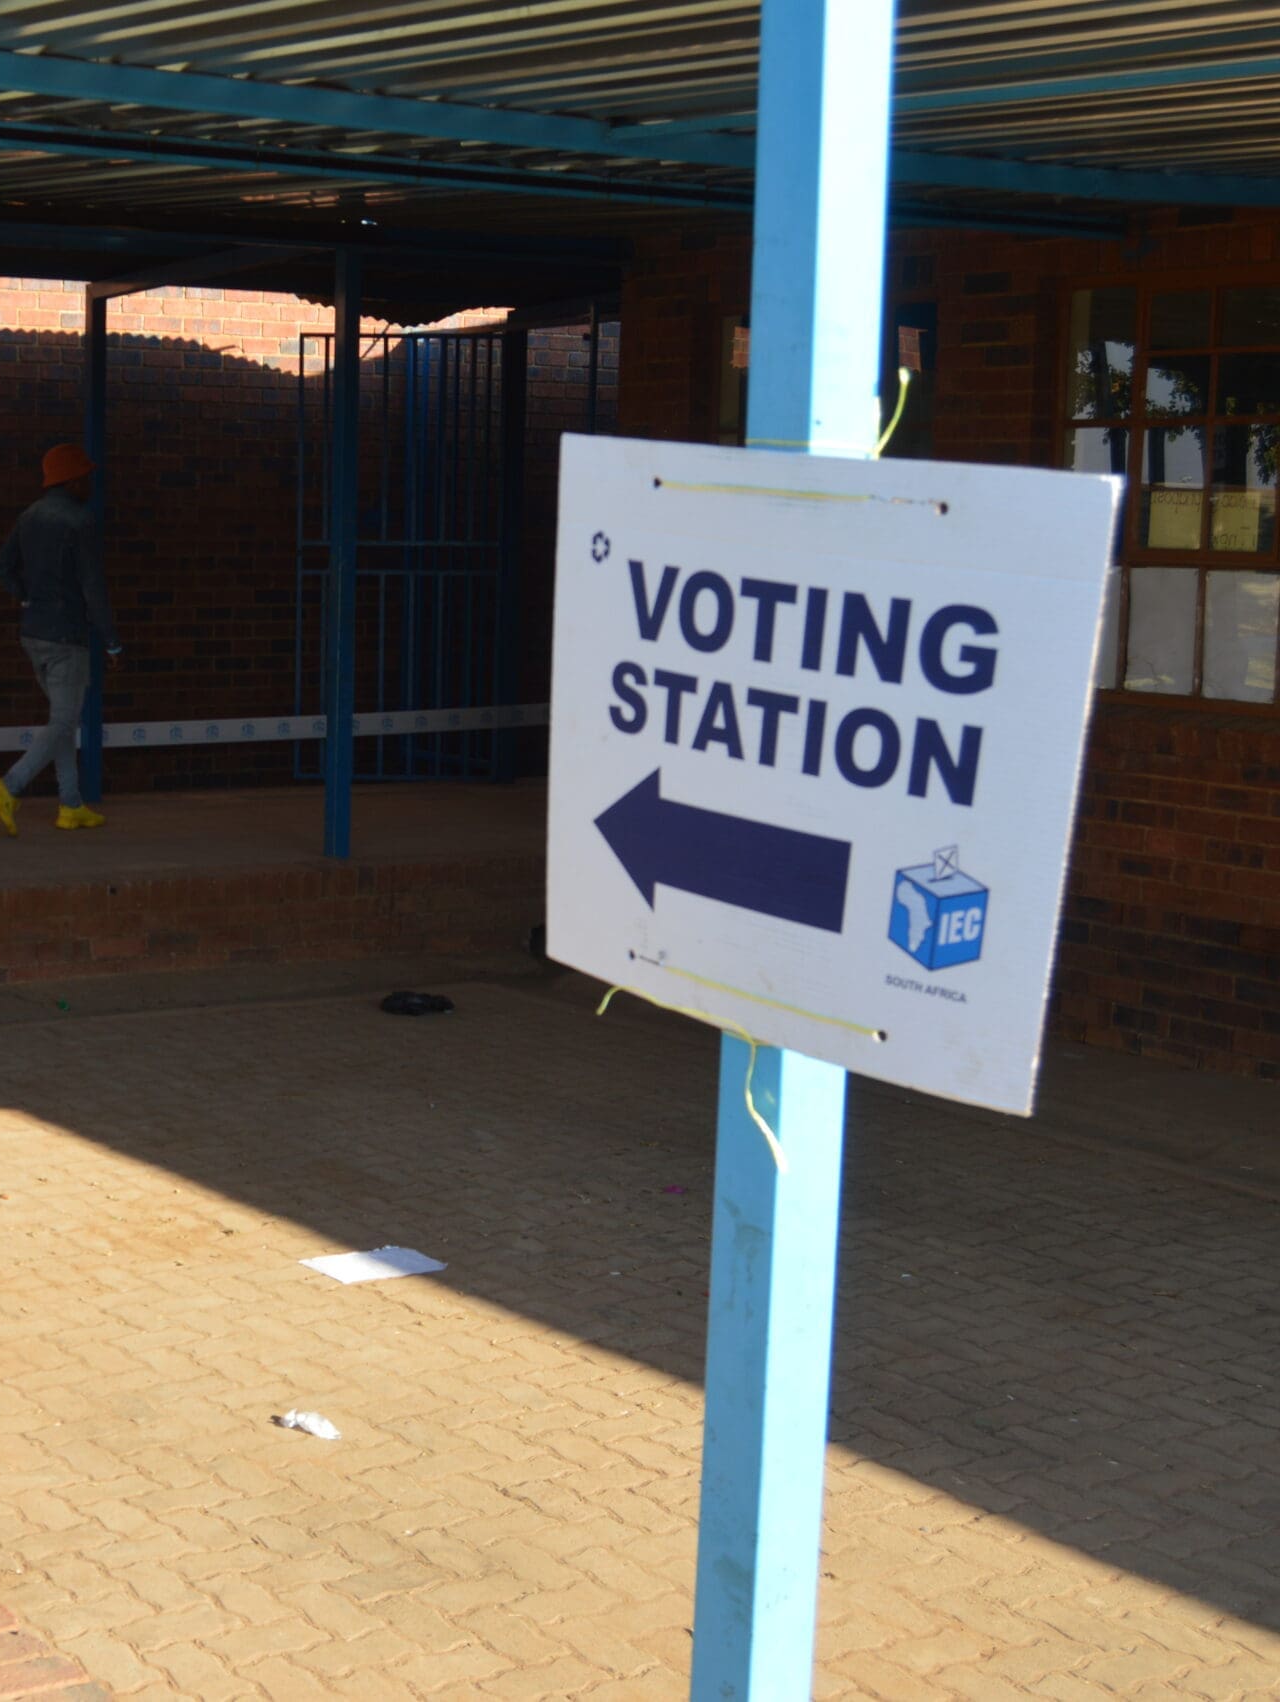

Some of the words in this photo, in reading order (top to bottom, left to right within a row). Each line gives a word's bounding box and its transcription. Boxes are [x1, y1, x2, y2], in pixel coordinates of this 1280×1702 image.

[627, 558, 1000, 695] VOTING
[607, 661, 984, 807] STATION
[938, 908, 982, 945] IEC
[885, 974, 923, 993] SOUTH
[925, 985, 967, 1003] AFRICA
